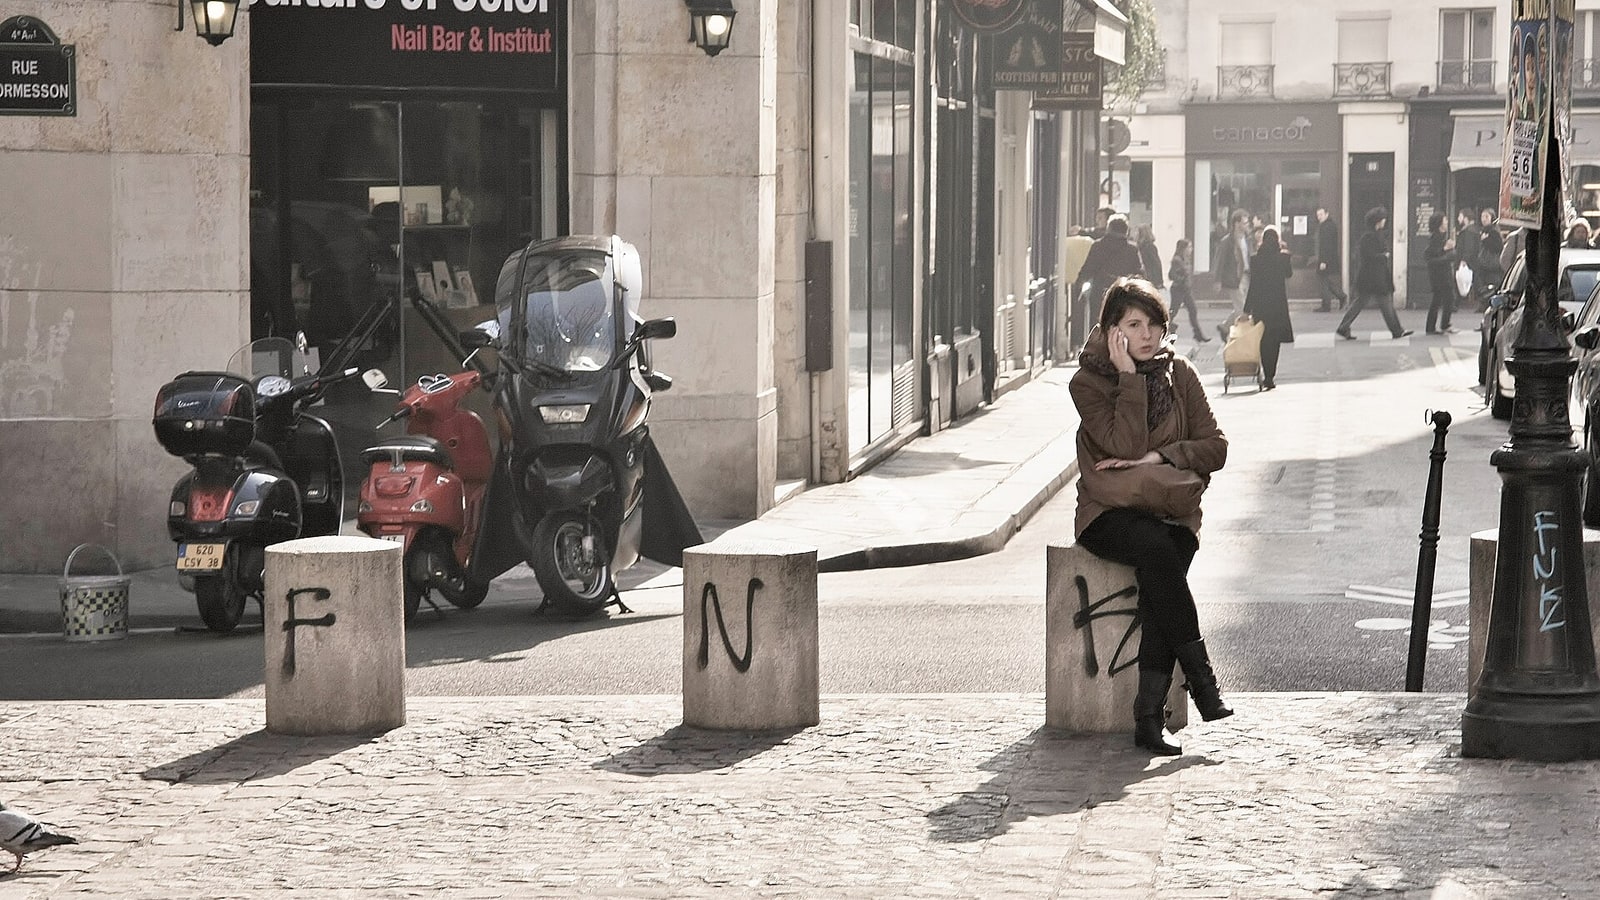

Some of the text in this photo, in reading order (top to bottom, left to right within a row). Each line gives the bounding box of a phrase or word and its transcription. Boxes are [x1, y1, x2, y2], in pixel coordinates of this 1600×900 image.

[391, 24, 551, 53] Nail Bar & Institut
[12, 60, 38, 75] RUE
[995, 71, 1038, 83] SCOTTISH
[1512, 156, 1530, 175] 5 6
[196, 545, 214, 555] 620
[207, 558, 219, 567] 38
[698, 578, 764, 673] N
[281, 587, 337, 683] F
